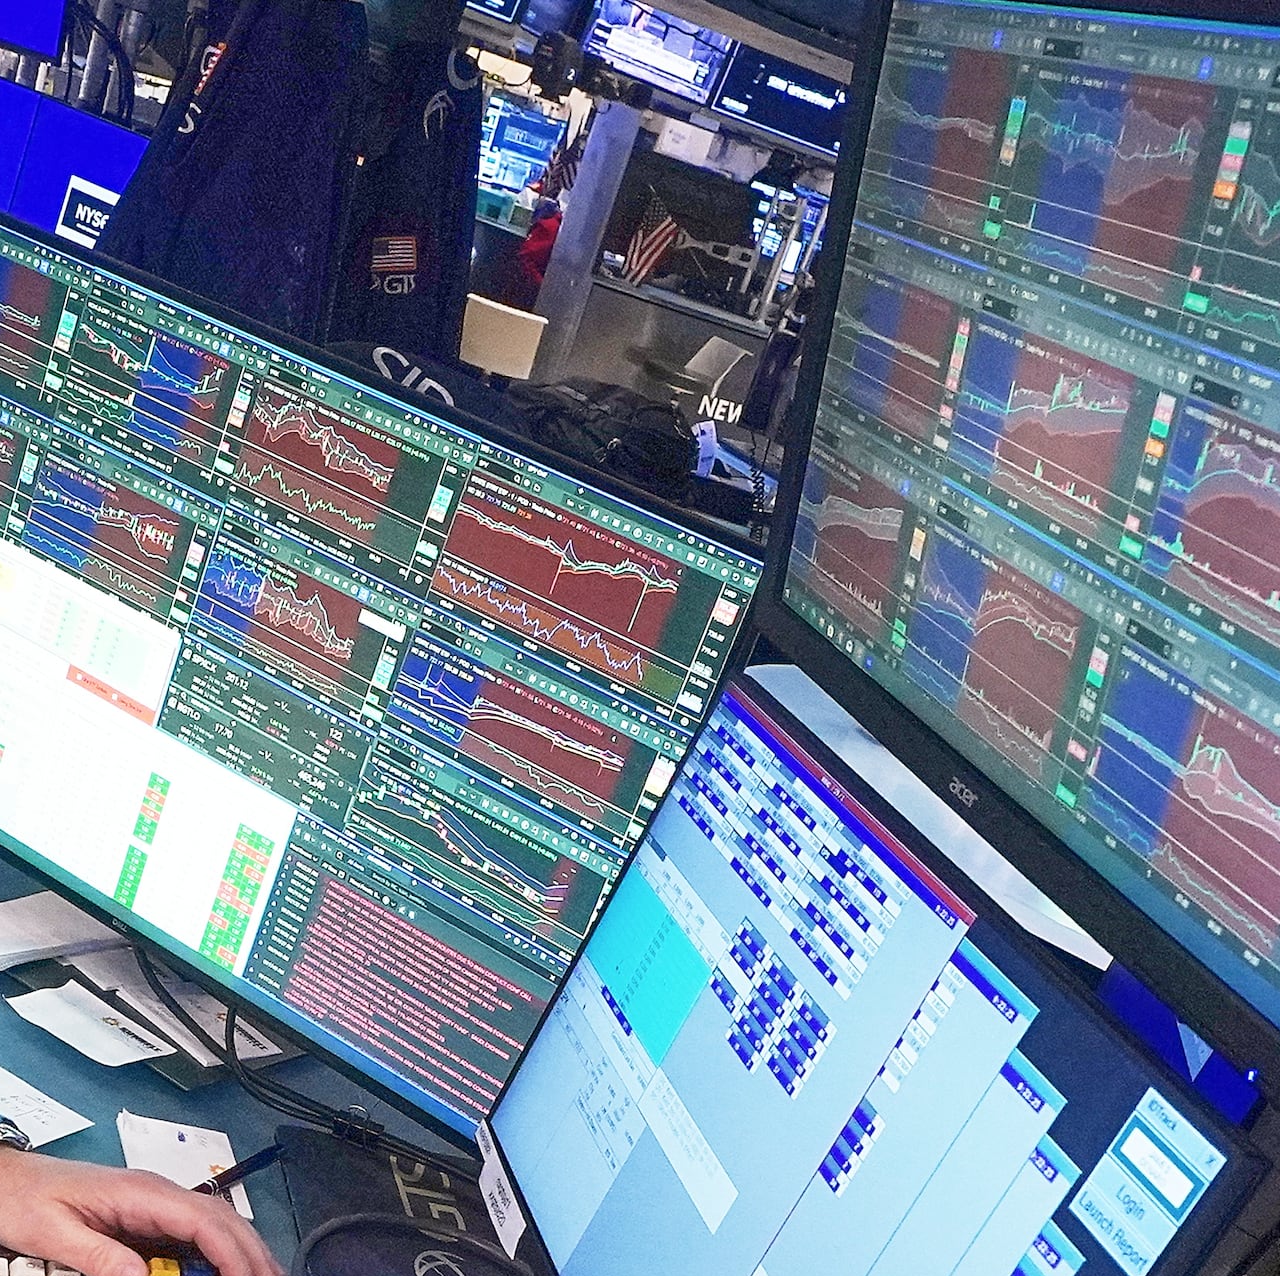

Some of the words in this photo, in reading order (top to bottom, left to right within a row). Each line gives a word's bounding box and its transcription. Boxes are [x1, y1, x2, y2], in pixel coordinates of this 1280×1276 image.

[948, 775, 979, 809] acer
[1115, 1184, 1146, 1221] Login
[1078, 1190, 1114, 1240] Launch
[1114, 1223, 1149, 1273] Report
